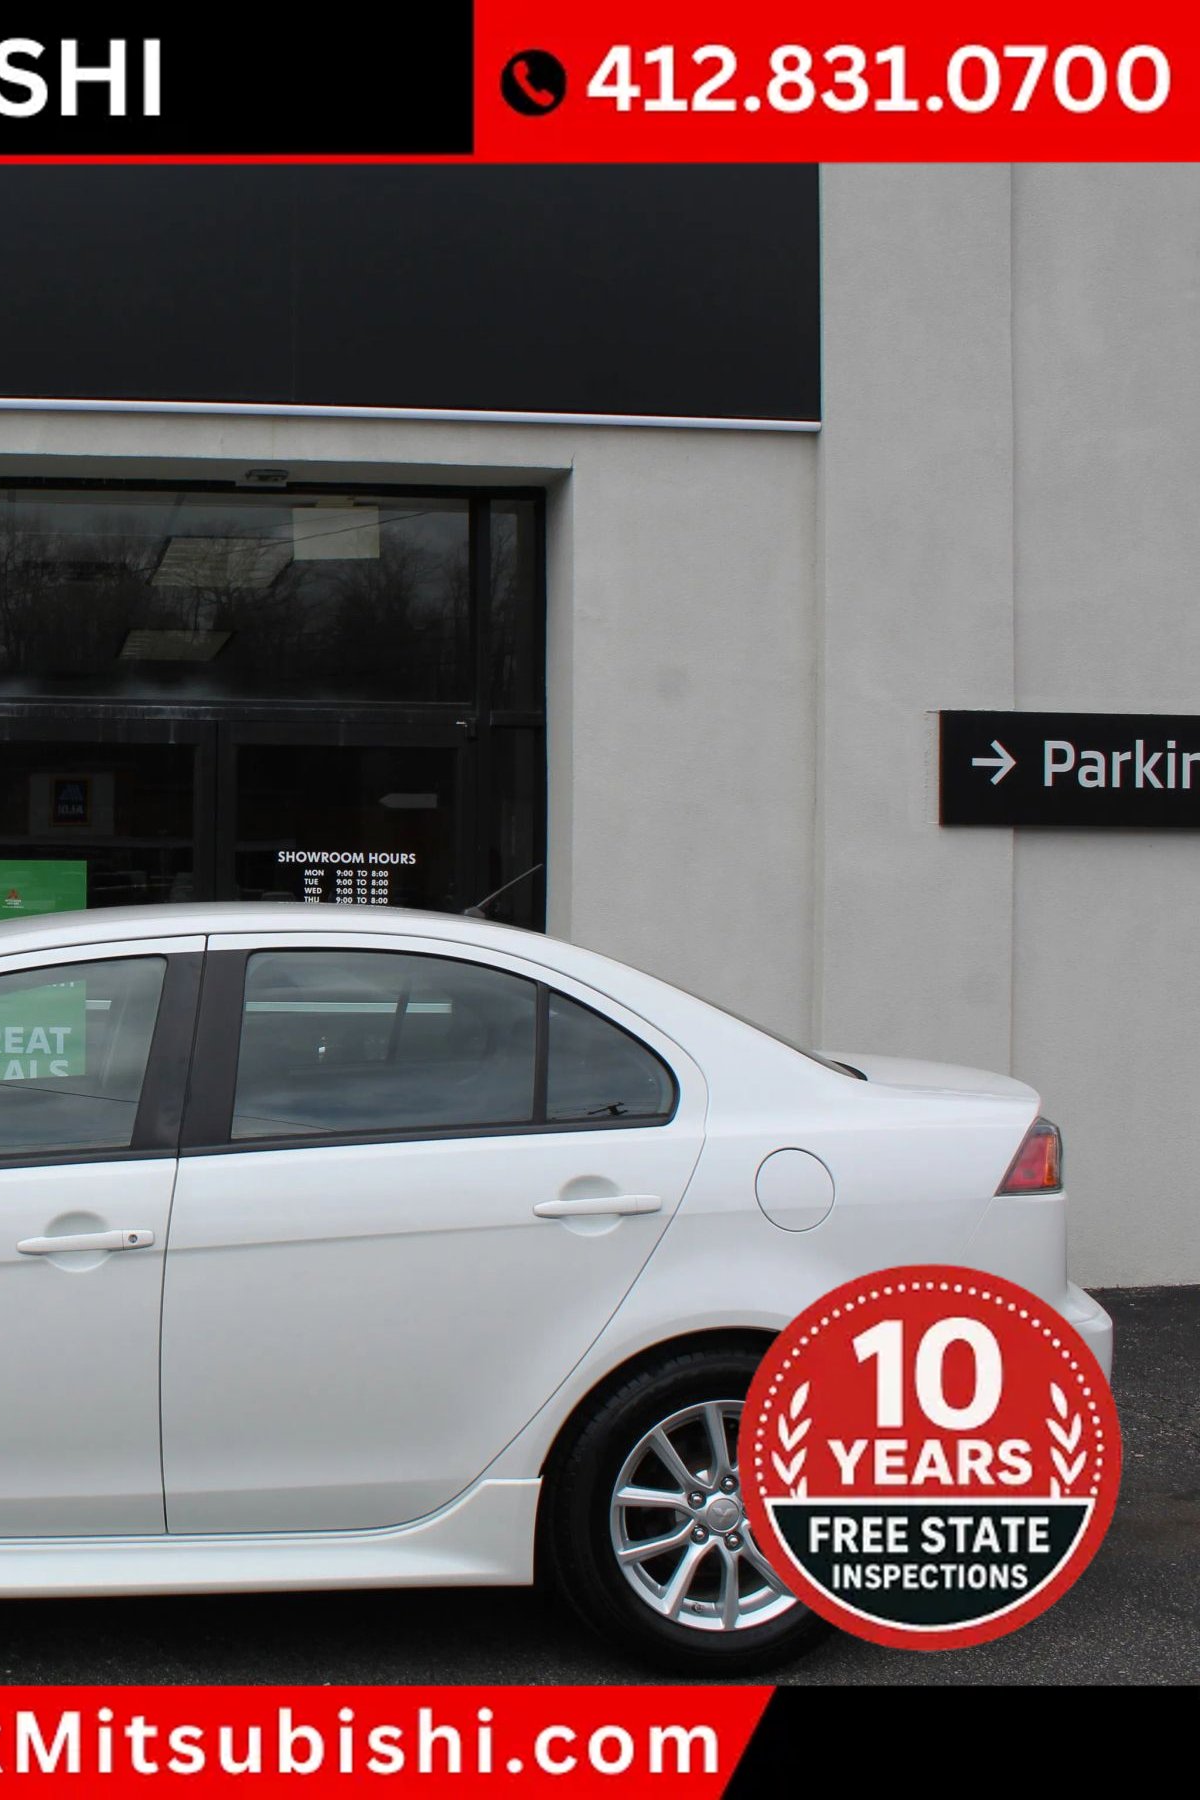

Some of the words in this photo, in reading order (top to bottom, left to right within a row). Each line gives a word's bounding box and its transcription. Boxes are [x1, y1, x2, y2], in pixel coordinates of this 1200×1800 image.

[278, 851, 365, 864] SHOWROOM
[369, 853, 417, 865] HOURS
[336, 870, 354, 878] 9:00
[357, 870, 368, 878] TO
[336, 878, 354, 886] 9:00
[357, 878, 368, 886] TO
[336, 887, 354, 895] 9:00
[357, 887, 368, 895] TO
[336, 896, 354, 904] 9:00
[357, 896, 368, 904] TO
